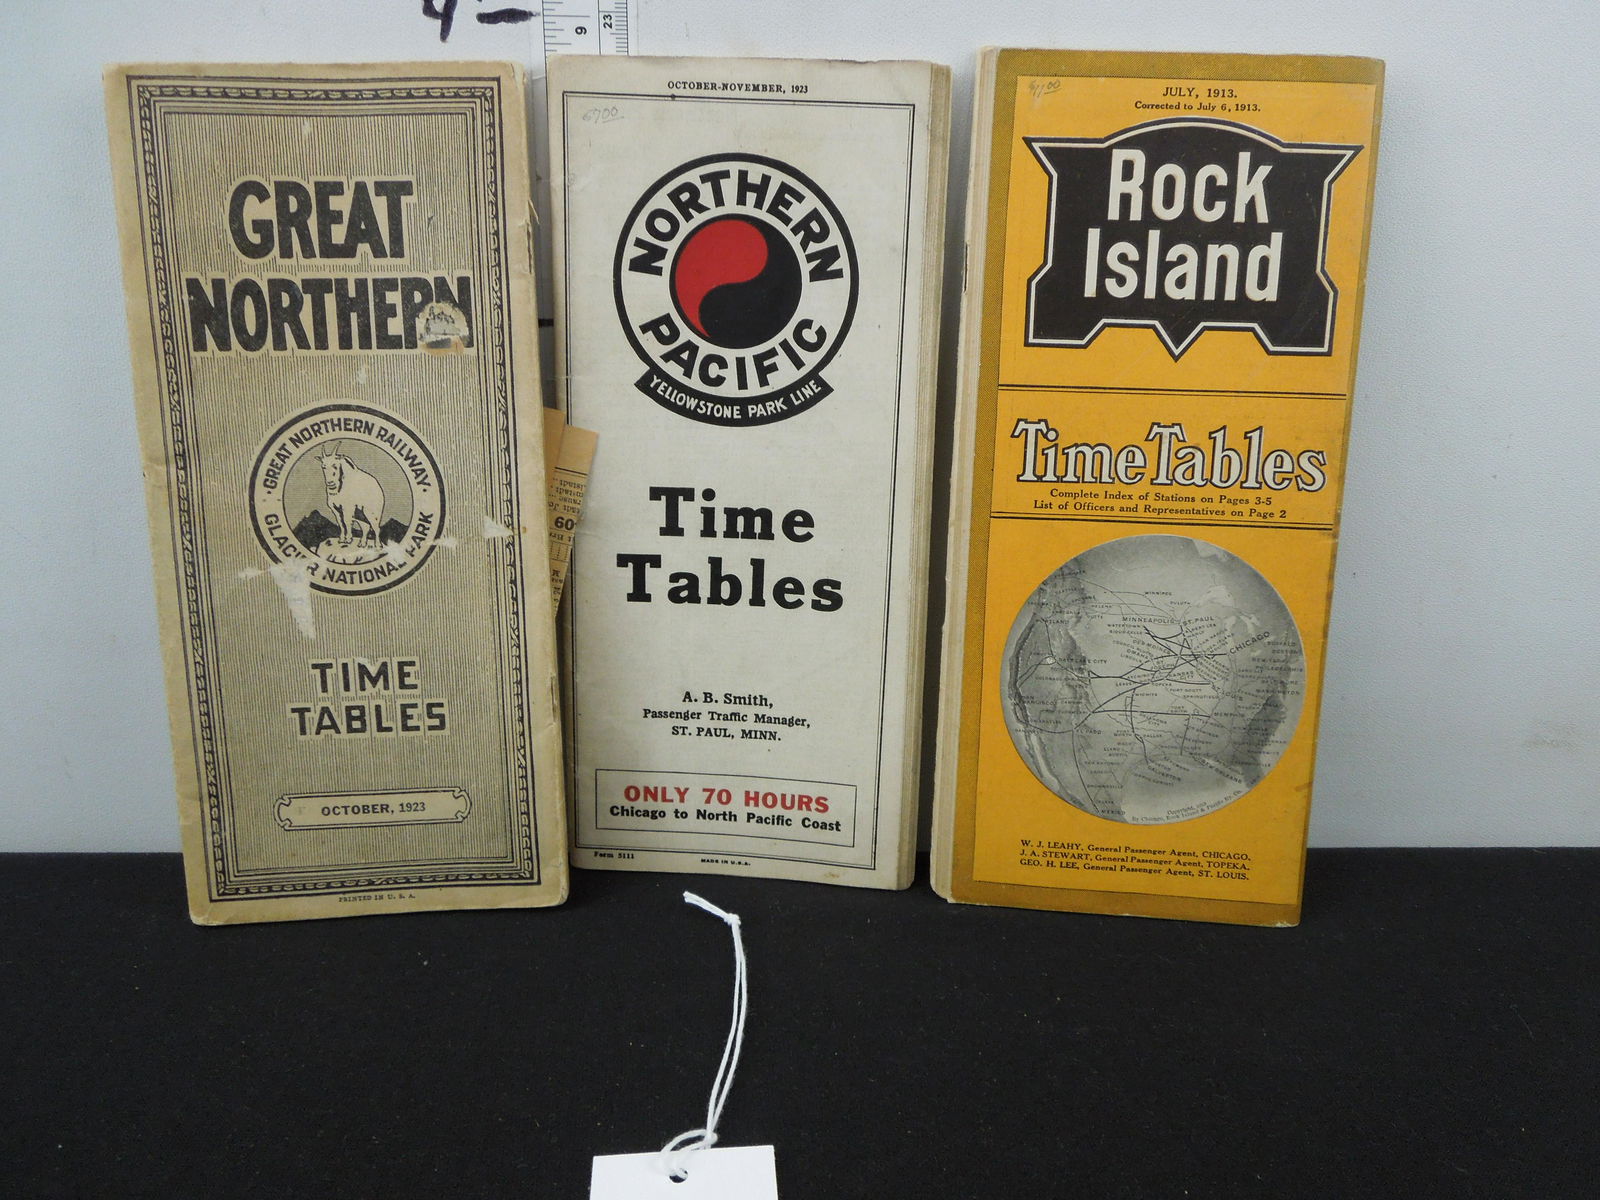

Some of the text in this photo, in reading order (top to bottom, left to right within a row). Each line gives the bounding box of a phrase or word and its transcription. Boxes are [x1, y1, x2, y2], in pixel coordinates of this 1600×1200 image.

[575, 25, 587, 35] 9
[603, 14, 612, 29] 23
[667, 81, 808, 94] OCTOBER-NOVEMBER, 1923
[1162, 87, 1238, 99] JULY, 1913.
[1134, 101, 1261, 113] Corrected to July 6, 1913.
[1107, 148, 1273, 224] Rock
[229, 180, 413, 259] GREAT
[628, 169, 844, 282] NORTHERN
[1083, 228, 1283, 302] Island
[186, 276, 475, 352] NORTHERN
[638, 312, 827, 390] PACIFIC
[650, 375, 822, 419] YELLOWSTONE PARK LINE
[263, 418, 432, 490] GREAT NORTHERN RAILWAY
[1010, 418, 1327, 492] Time Tables
[1033, 500, 1287, 519] List of Officers and Representatives on Page 2
[1050, 488, 1099, 500] Complete
[1104, 490, 1133, 500] Index
[1138, 491, 1150, 501] of
[1154, 492, 1195, 503] Stations
[1218, 495, 1249, 506] Pages
[1254, 497, 1273, 506] 3-5
[649, 486, 815, 543] Time
[264, 513, 319, 576] GLACR
[616, 553, 844, 612] Tables
[1229, 631, 1270, 654] CHICAGO
[311, 660, 418, 693] TIME
[682, 691, 774, 709] A. B. Smith,
[290, 702, 446, 736] TABLES
[642, 708, 811, 728] Passenger Traffic Manager,
[671, 725, 782, 741] ST. PAUL, MINN.
[321, 802, 426, 817] OCTOBER, 1923
[623, 785, 830, 814] ONLY 70 HOURS
[609, 805, 842, 832] Chicago to North Pacific Coast
[594, 851, 634, 860] Form 5111
[1020, 839, 1034, 847] W.
[1036, 840, 1045, 849] J.
[1088, 844, 1122, 853] General
[1124, 846, 1166, 857] Passenger
[1170, 848, 1199, 859] Agent,
[1030, 850, 1040, 858] A.
[1095, 854, 1129, 863] General
[1130, 855, 1172, 866] Passenger
[1175, 859, 1204, 868] Agent,
[1019, 858, 1249, 880] GEO. H. LEE, General Passenger Agent, ST. LOUIS.
